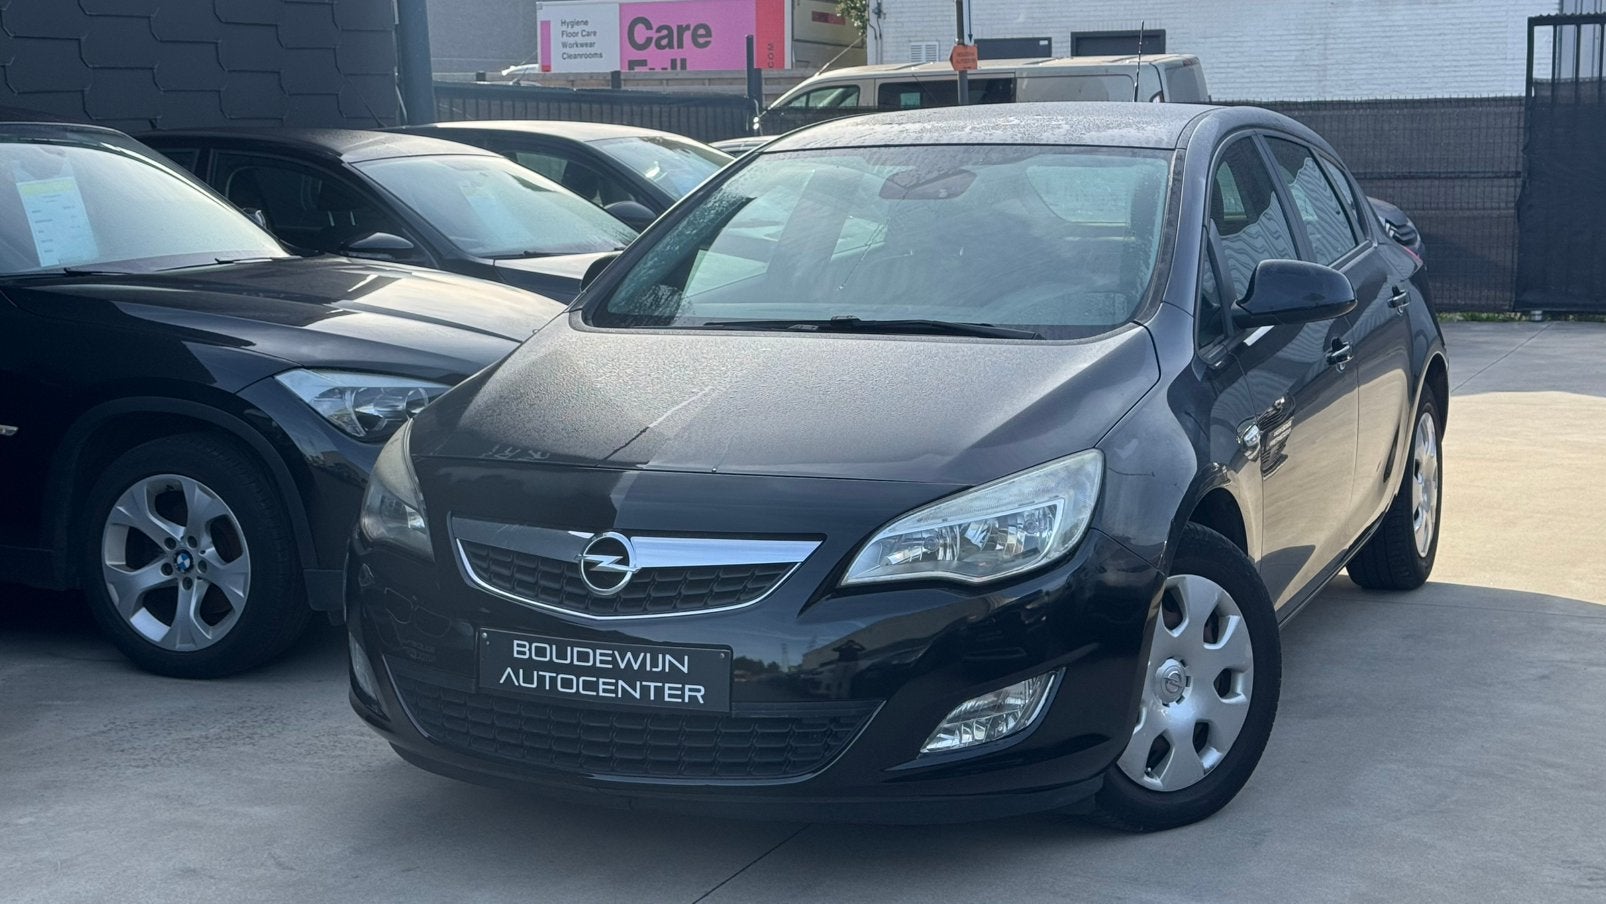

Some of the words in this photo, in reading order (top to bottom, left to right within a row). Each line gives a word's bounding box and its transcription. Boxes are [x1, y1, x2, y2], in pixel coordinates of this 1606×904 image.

[560, 18, 589, 28] Hygiene
[561, 30, 580, 38] Floor
[581, 29, 597, 38] Care
[627, 16, 713, 51] Care
[561, 40, 596, 49] Workwear
[561, 52, 603, 60] Cleanrooms
[512, 639, 689, 674] BOUDEWIJN
[499, 667, 706, 704] AUTOCENTER
